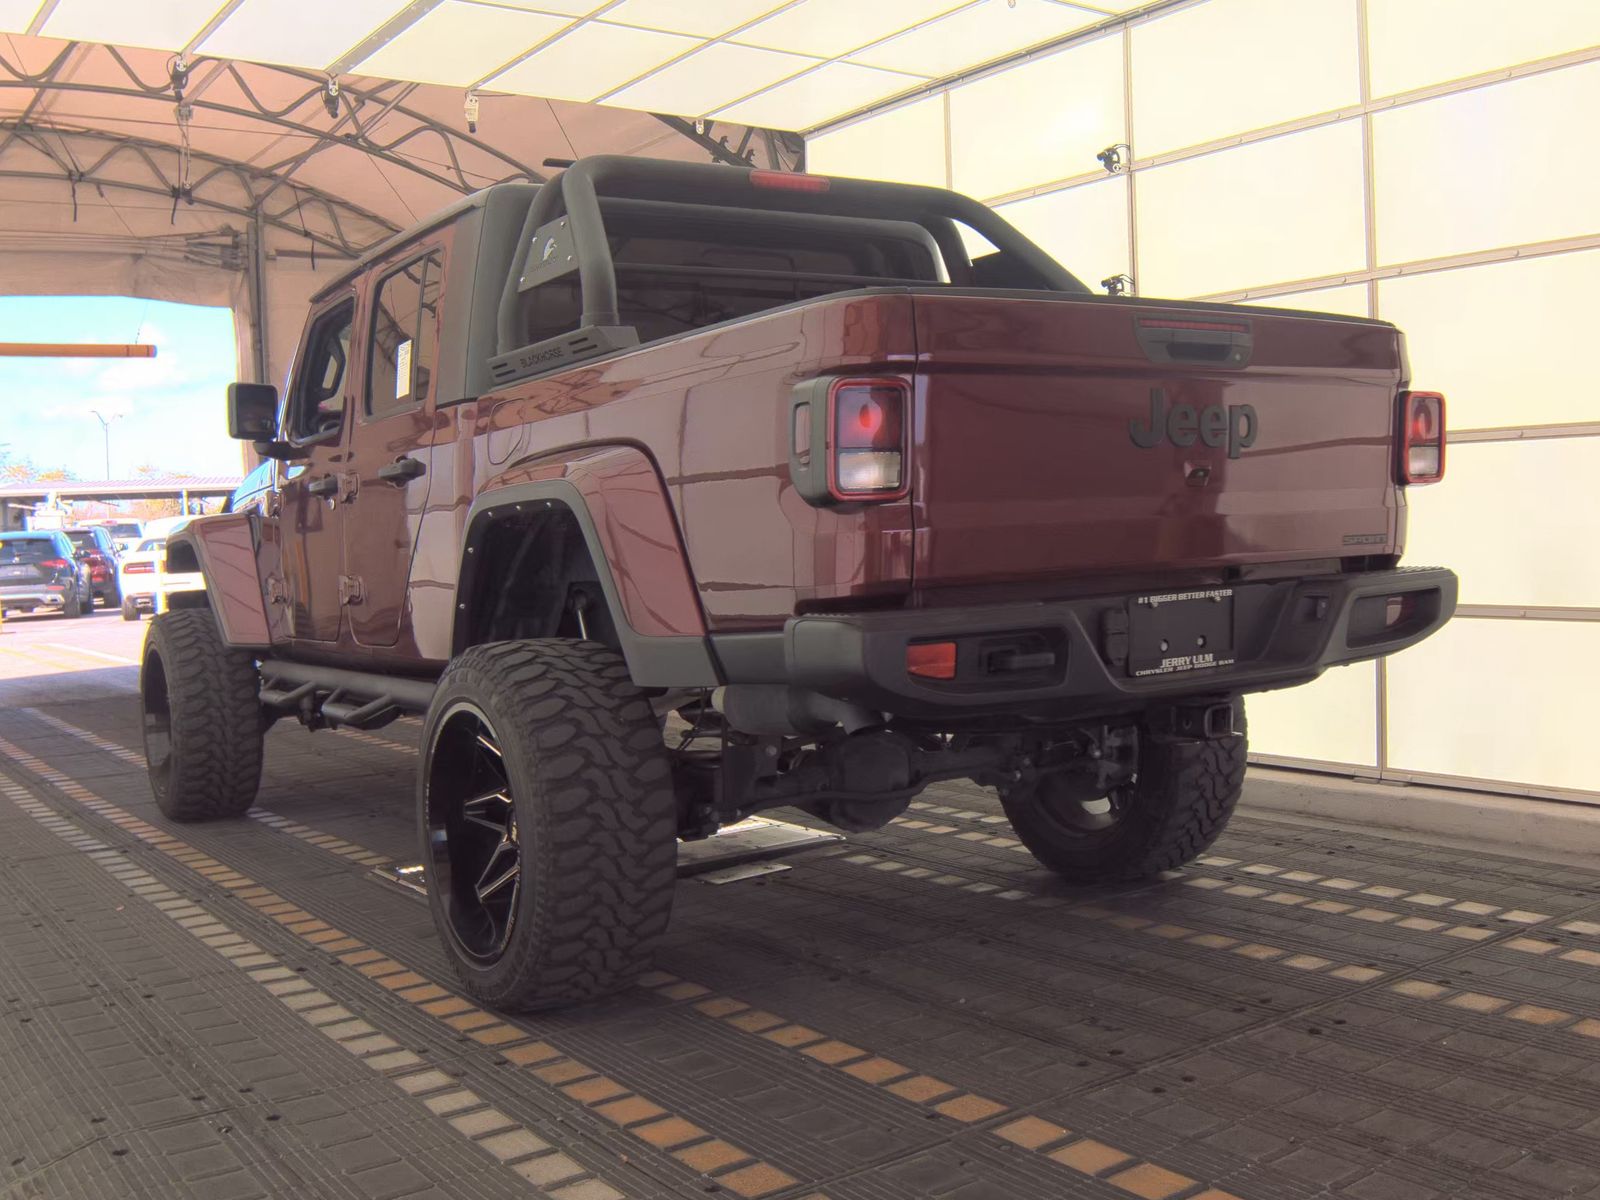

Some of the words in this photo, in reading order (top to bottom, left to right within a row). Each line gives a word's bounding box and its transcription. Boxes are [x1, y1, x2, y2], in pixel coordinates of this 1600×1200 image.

[1128, 387, 1258, 459] Jeep
[1149, 594, 1177, 603] BIGGER
[1178, 591, 1205, 600] BETTER
[1206, 589, 1232, 598] FASTER
[1160, 656, 1192, 668] JERRY
[1192, 653, 1214, 664] ULM
[1135, 667, 1173, 676] CHRYSLER
[1194, 661, 1217, 669] DODGE
